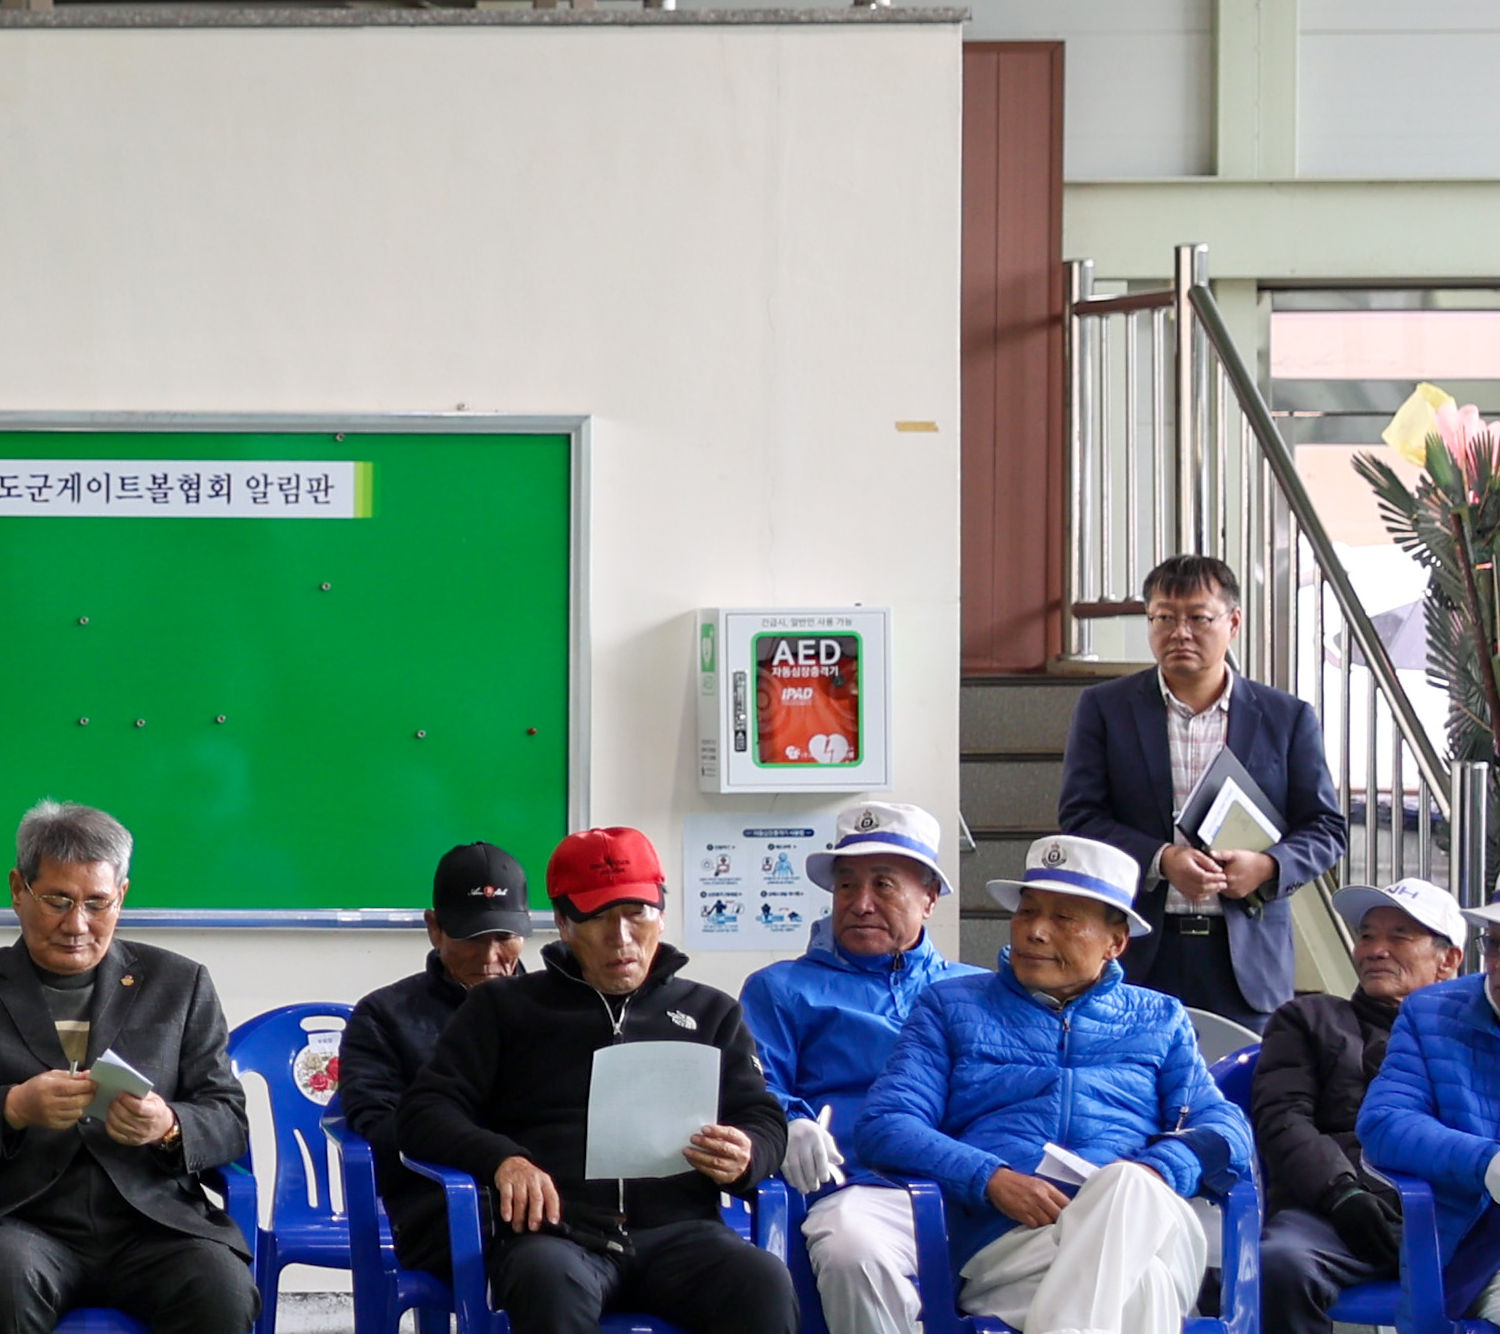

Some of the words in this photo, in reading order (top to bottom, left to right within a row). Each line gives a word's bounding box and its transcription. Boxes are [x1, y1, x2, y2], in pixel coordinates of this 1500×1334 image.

[245, 472, 336, 506] 알림판
[771, 639, 841, 666] AED
[771, 665, 839, 678] 자동심장충격기
